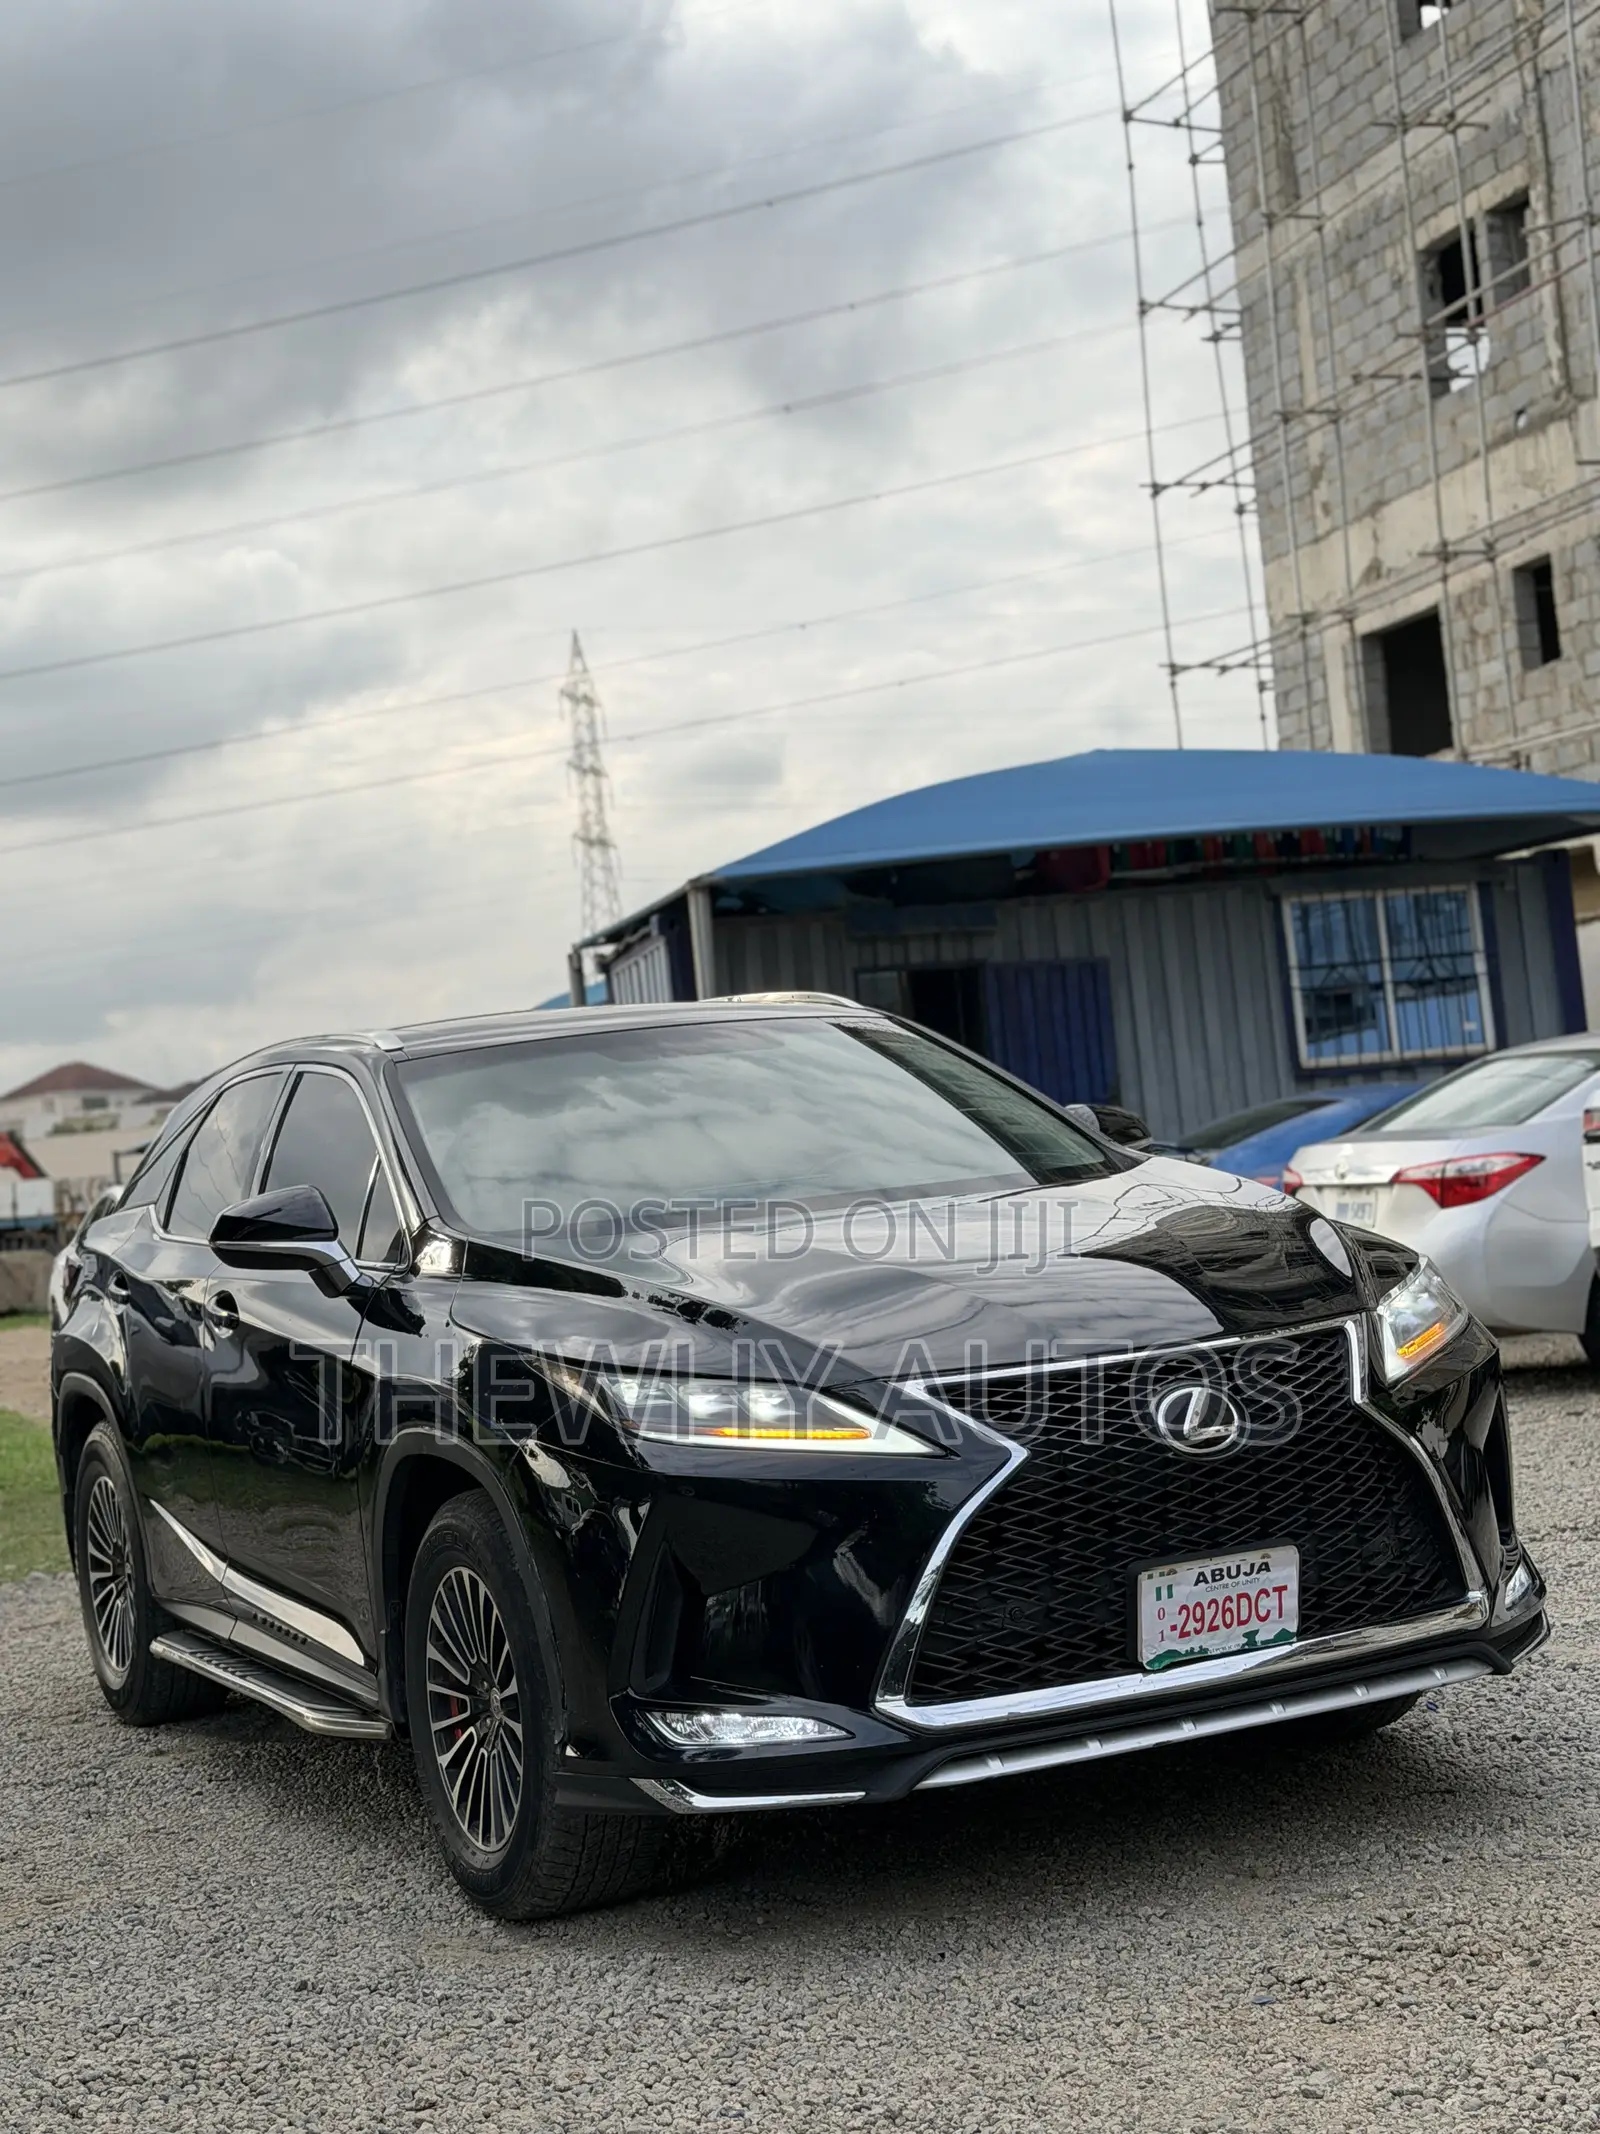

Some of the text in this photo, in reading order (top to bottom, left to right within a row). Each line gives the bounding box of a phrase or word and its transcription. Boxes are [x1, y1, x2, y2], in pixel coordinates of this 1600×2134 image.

[1193, 1561, 1271, 1587] ABUJA
[1205, 1577, 1261, 1593] CENTRE OF UNITY
